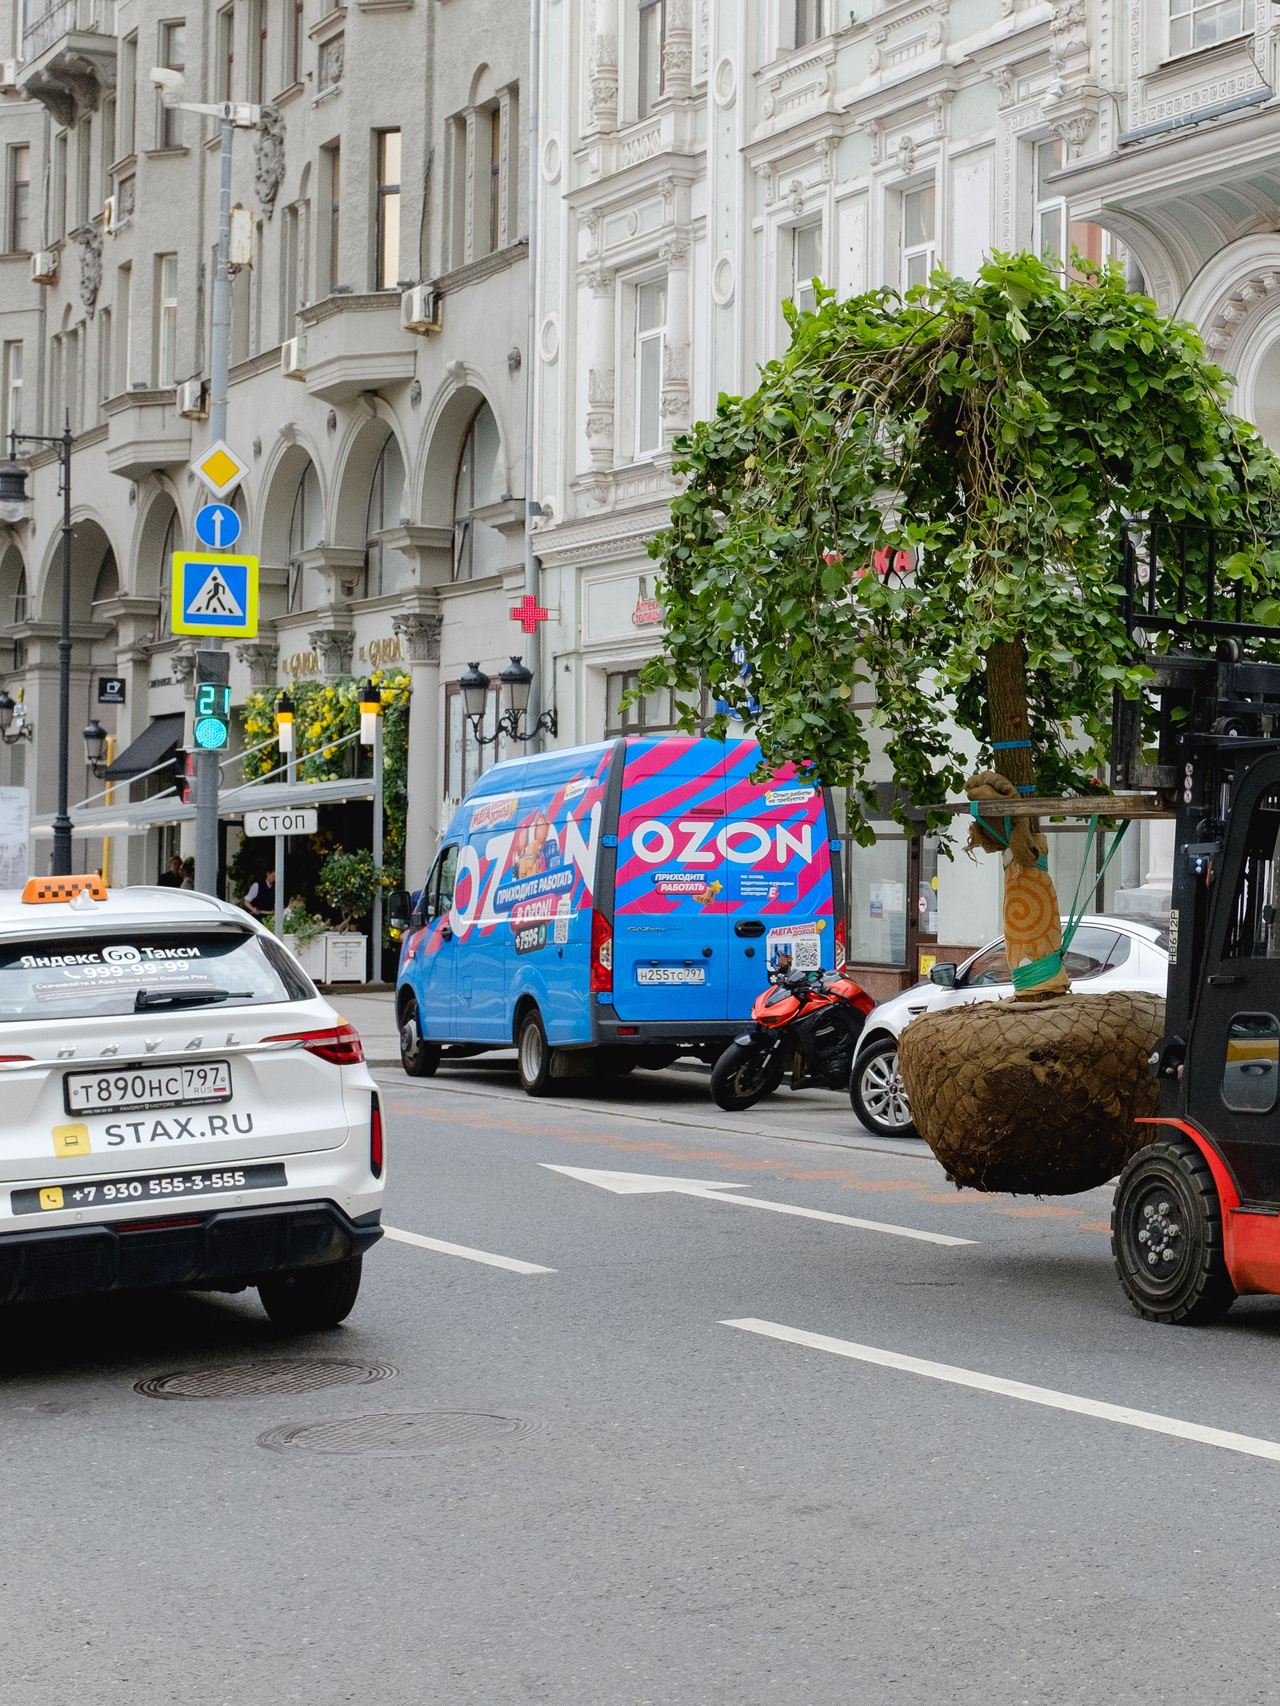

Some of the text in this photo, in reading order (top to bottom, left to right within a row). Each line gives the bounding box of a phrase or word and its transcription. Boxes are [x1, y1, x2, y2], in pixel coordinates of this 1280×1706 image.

[200, 685, 230, 715] 21
[258, 814, 307, 831] СТОП
[631, 820, 813, 864] OZON
[496, 870, 573, 905] ПРИХОДИТЕ РАБОТАТЬ
[654, 873, 705, 882] ПРИХОДИТЕ
[660, 882, 705, 892] РАБОТАТЬ
[770, 927, 793, 937] МЕГА
[792, 928, 816, 937] ДОХОД
[20, 952, 101, 969] Яндекс
[141, 947, 201, 960] Такси
[83, 960, 190, 978] 999-99-99
[685, 968, 702, 978] 797
[56, 1033, 241, 1058] HAVAL
[184, 1067, 220, 1088] 797
[193, 1085, 213, 1094] RUS
[105, 1112, 254, 1146] STAX.RU
[72, 1171, 246, 1202] +7 930 555-3-555
